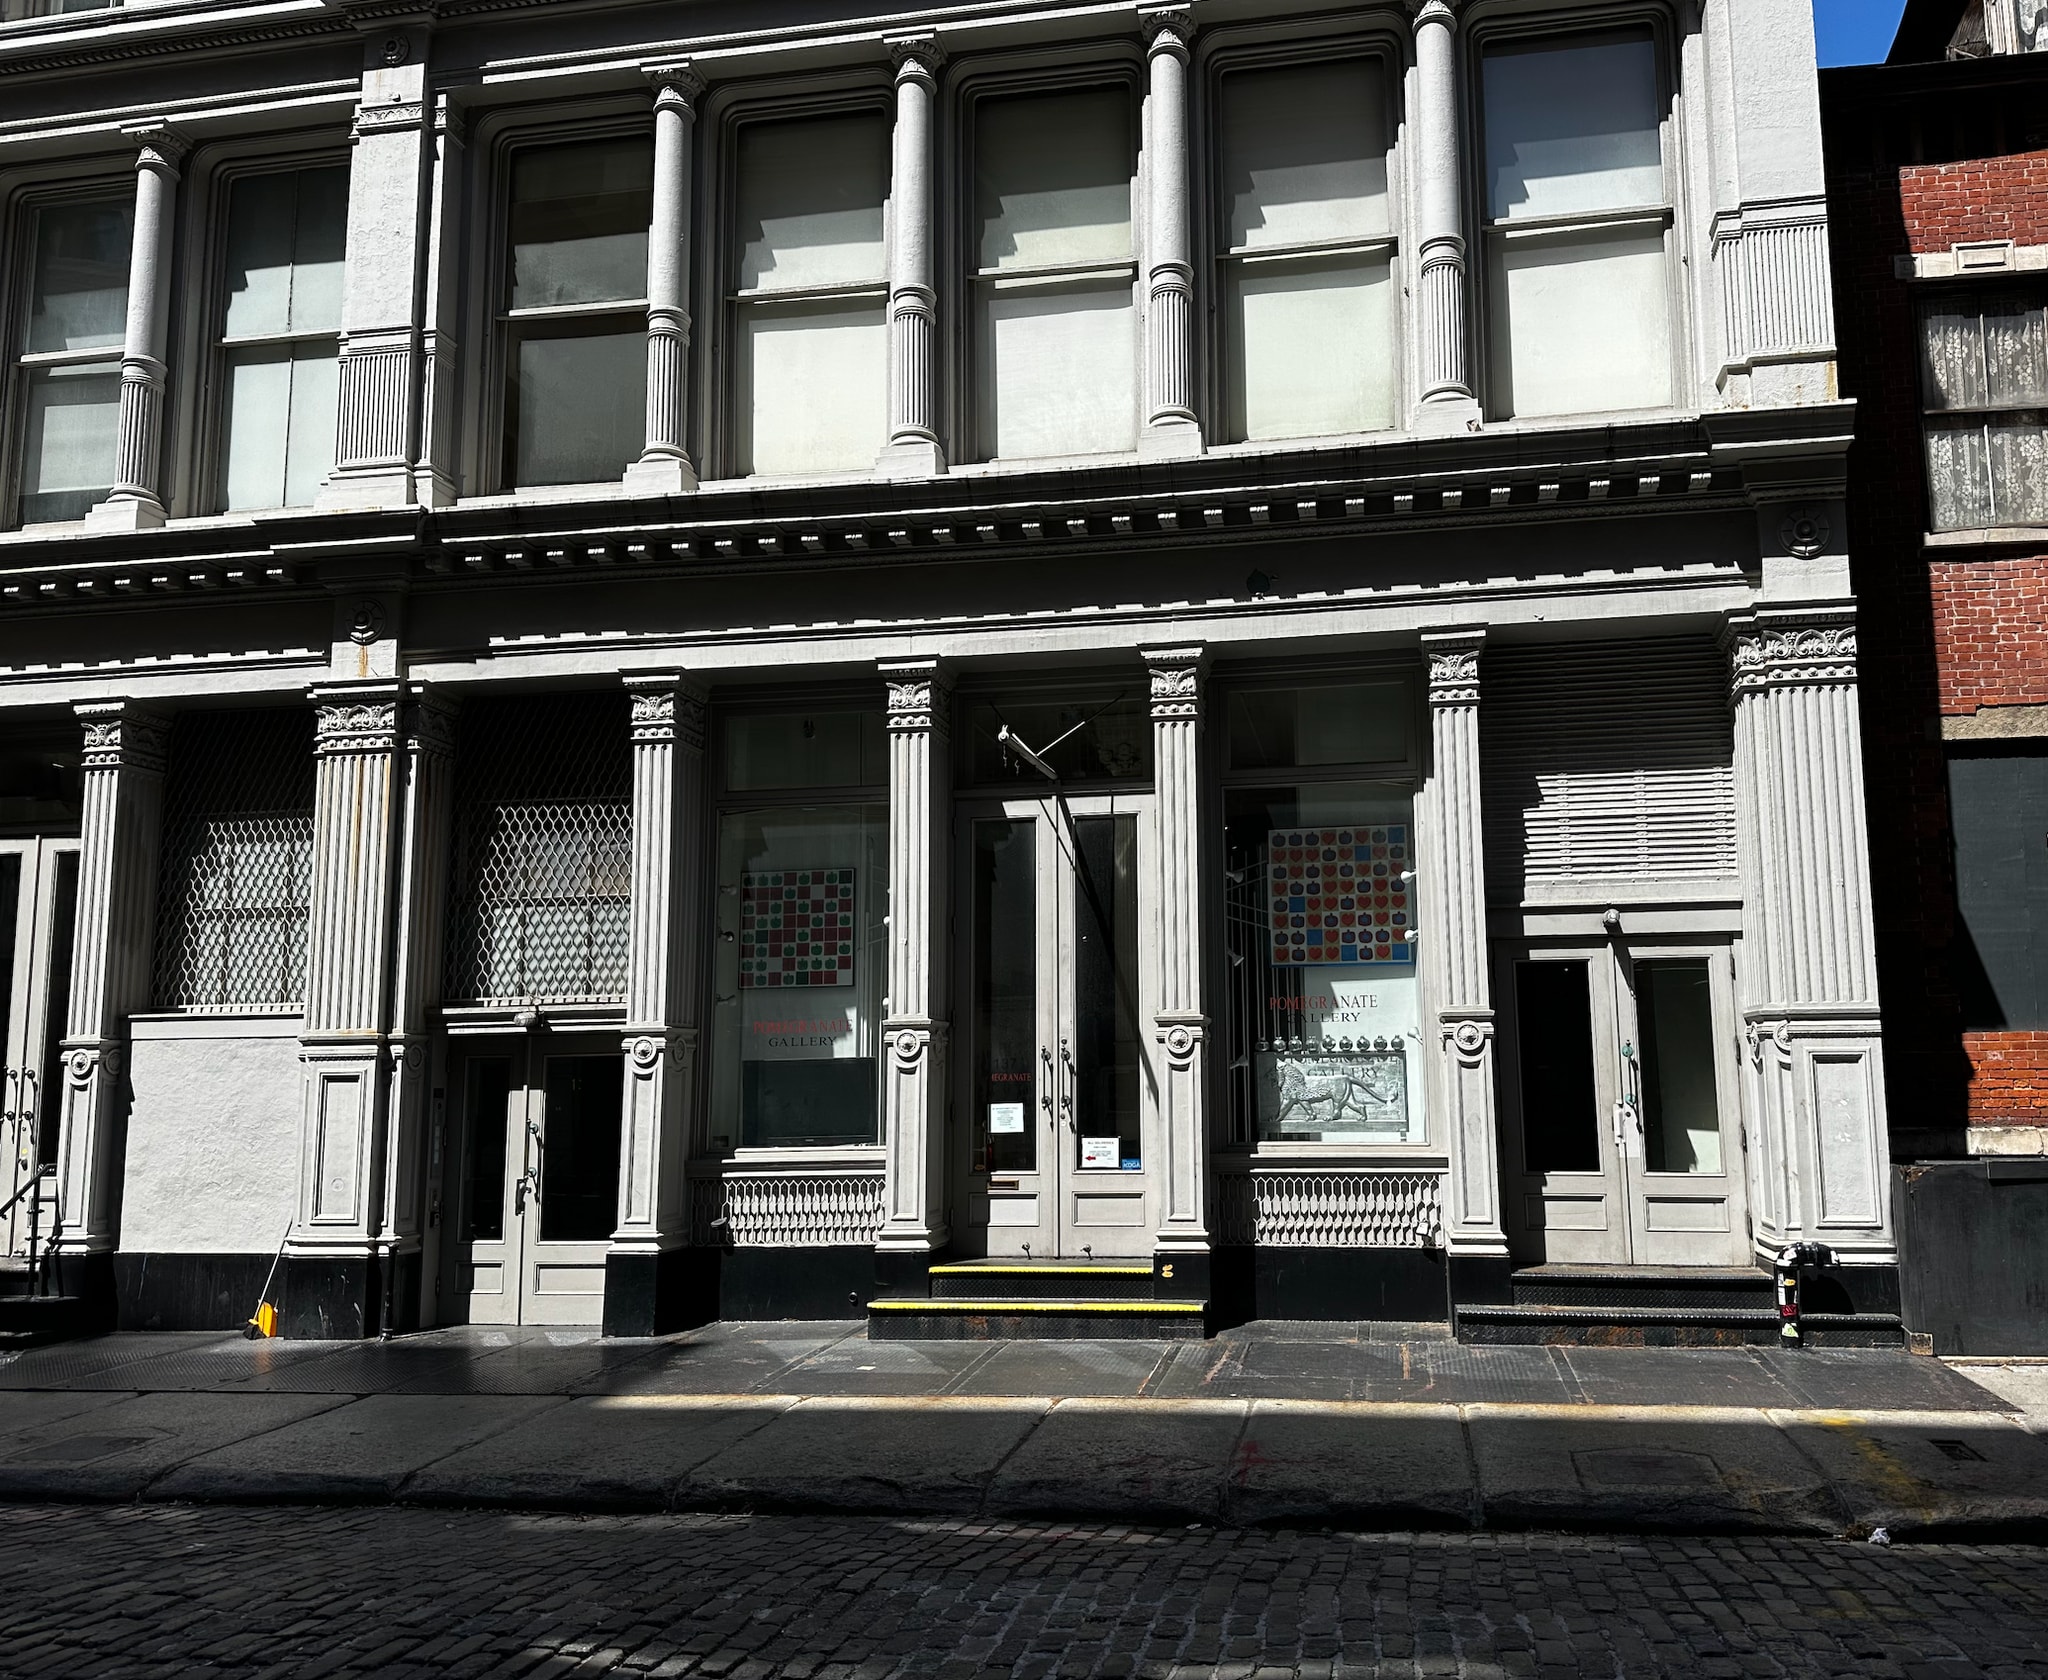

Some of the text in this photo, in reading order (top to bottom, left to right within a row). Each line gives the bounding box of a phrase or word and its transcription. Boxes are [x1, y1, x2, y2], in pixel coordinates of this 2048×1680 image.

[1269, 994, 1378, 1011] POMEGRANATE
[1287, 1012, 1361, 1024] GALLERY
[753, 1018, 853, 1035] POMEGRANATE
[768, 1036, 838, 1048] GALLERY
